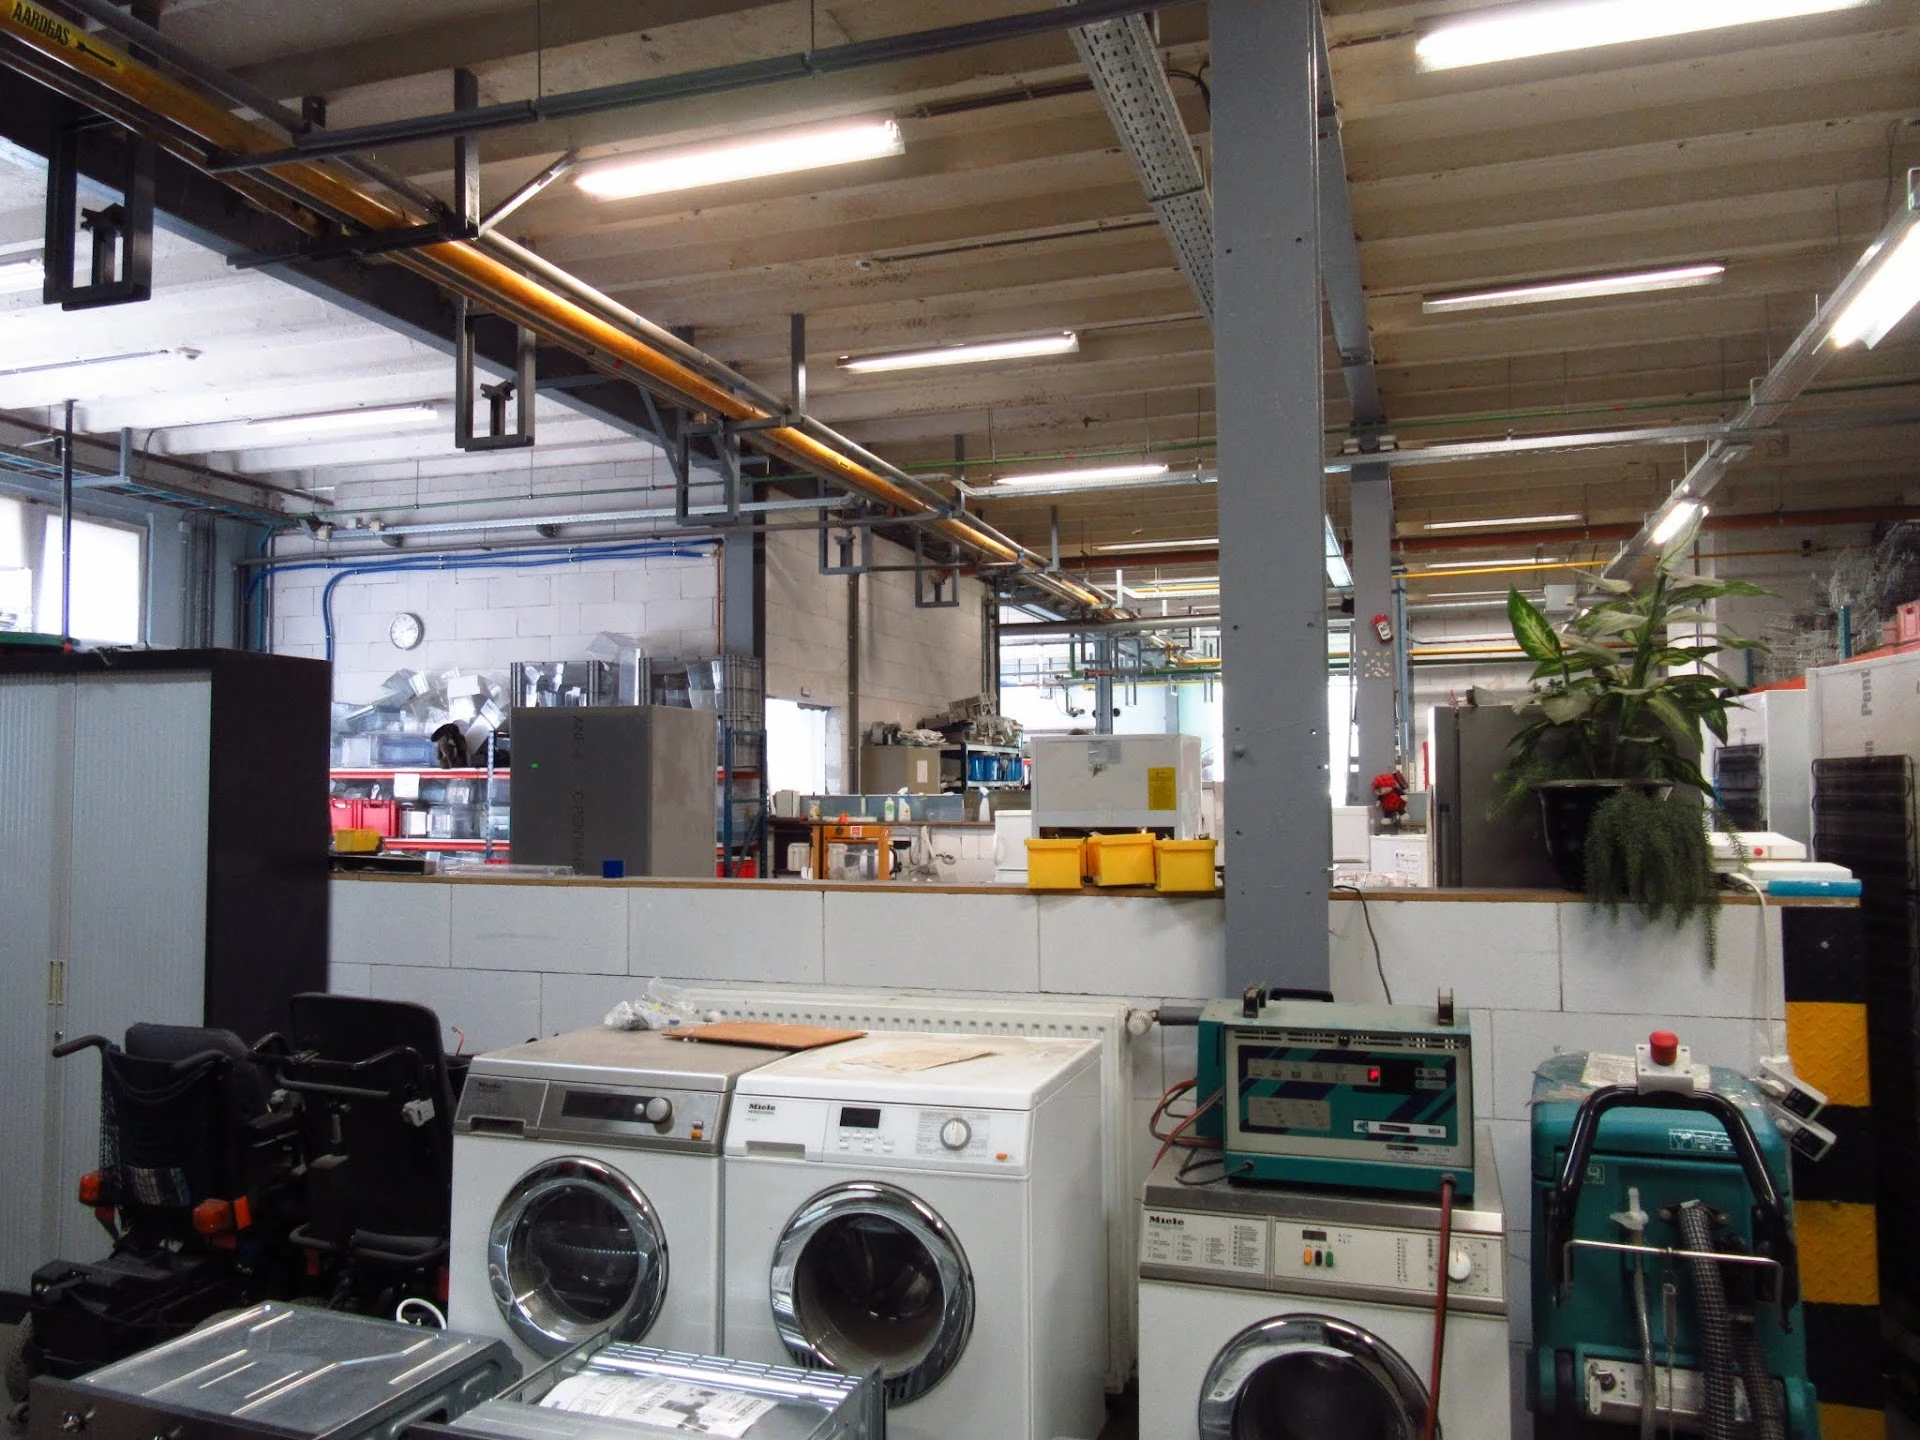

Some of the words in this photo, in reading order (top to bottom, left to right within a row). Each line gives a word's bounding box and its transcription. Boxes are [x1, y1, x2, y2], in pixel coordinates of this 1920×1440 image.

[12, 1, 70, 46] AARDGAS
[748, 1103, 776, 1111] Miele
[1149, 1216, 1185, 1226] Miele
